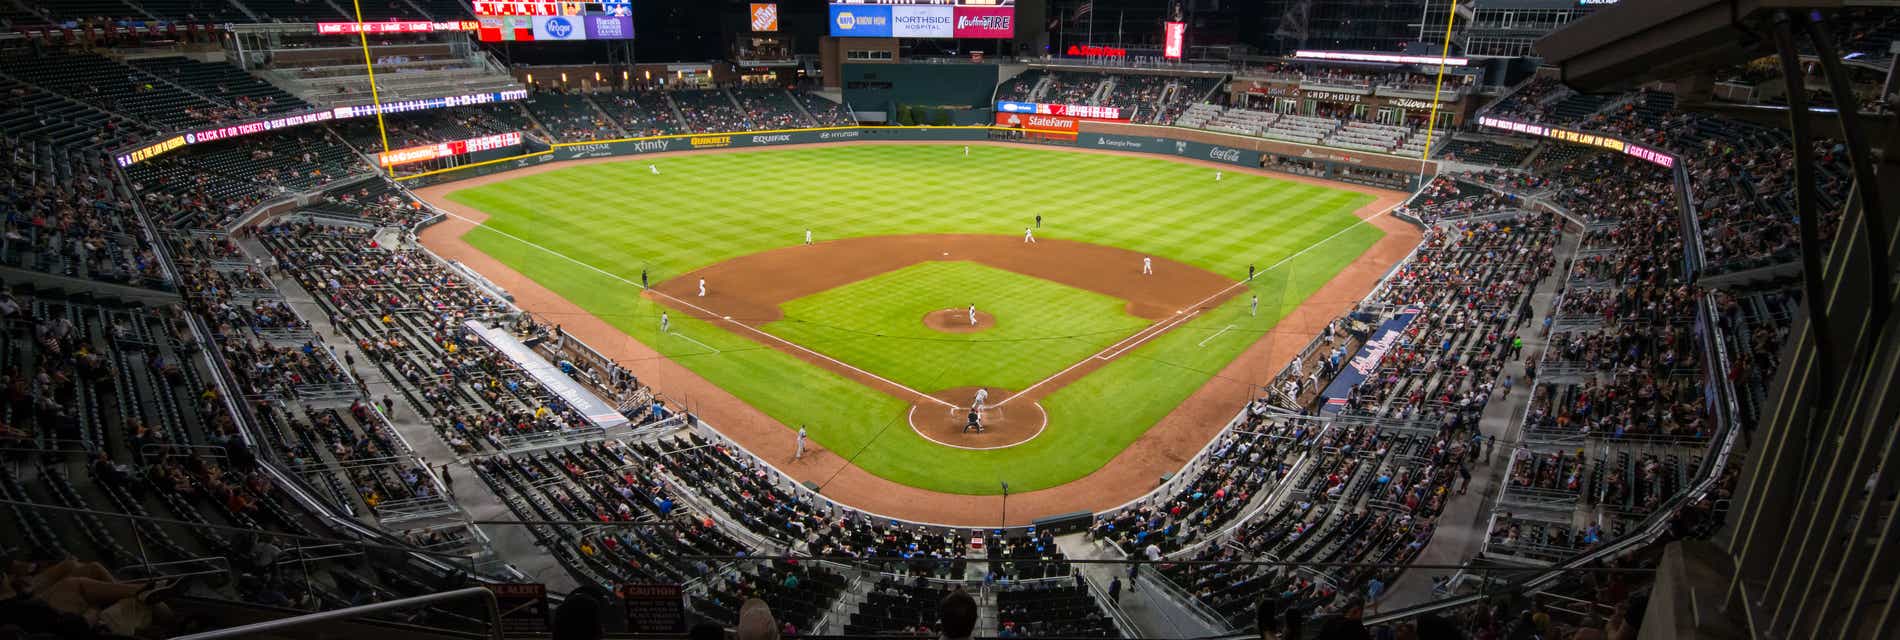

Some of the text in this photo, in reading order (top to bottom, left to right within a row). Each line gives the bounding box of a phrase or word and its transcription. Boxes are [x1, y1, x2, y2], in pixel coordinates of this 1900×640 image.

[839, 17, 854, 25] NAPA
[873, 16, 886, 25] HOW
[895, 16, 950, 24] NORTHSIDE
[983, 16, 1010, 30] TIRE
[547, 20, 571, 36] Kroger
[1332, 94, 1361, 102] HOUSE
[271, 119, 286, 128] SEAT
[286, 116, 304, 126] BELTS
[303, 113, 318, 123] SAVE
[196, 122, 264, 142] CLICK IT OR TICKET!
[1485, 118, 1497, 126] SEAT
[1551, 128, 1558, 138] IT
[1559, 130, 1565, 139] IS
[1566, 132, 1579, 142] THE
[1580, 134, 1594, 144] LAW
[1595, 136, 1603, 146] IN
[752, 134, 791, 144] EQUIFAX
[634, 140, 669, 152] xfinity
